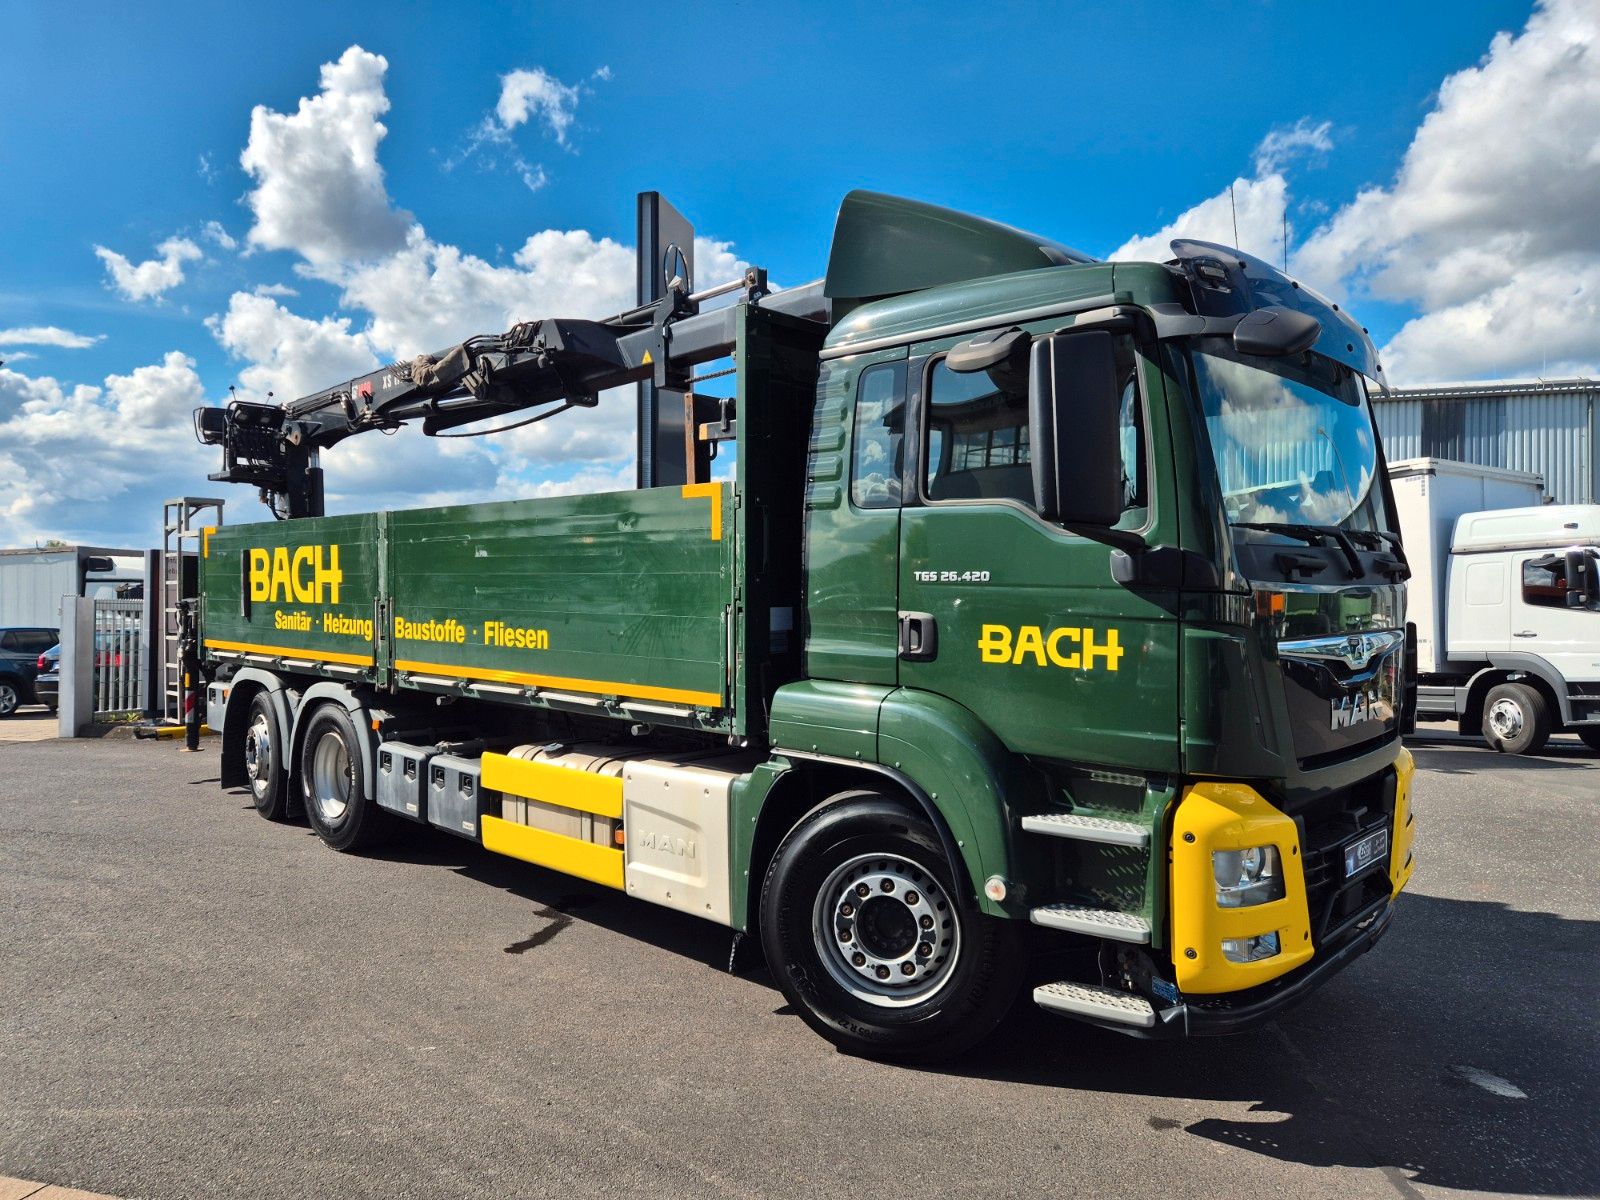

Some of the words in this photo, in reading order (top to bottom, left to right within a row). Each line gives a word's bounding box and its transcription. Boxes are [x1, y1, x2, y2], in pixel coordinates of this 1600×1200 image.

[249, 544, 343, 604] BACH
[914, 571, 938, 582] TGS
[940, 571, 991, 582] 26.420
[274, 609, 312, 632] Sanitär
[323, 612, 373, 642] Heizung
[394, 616, 466, 644] Baustoffe
[484, 621, 549, 650] Fliesen
[978, 624, 1124, 671] BACH
[639, 829, 696, 859] MAN
